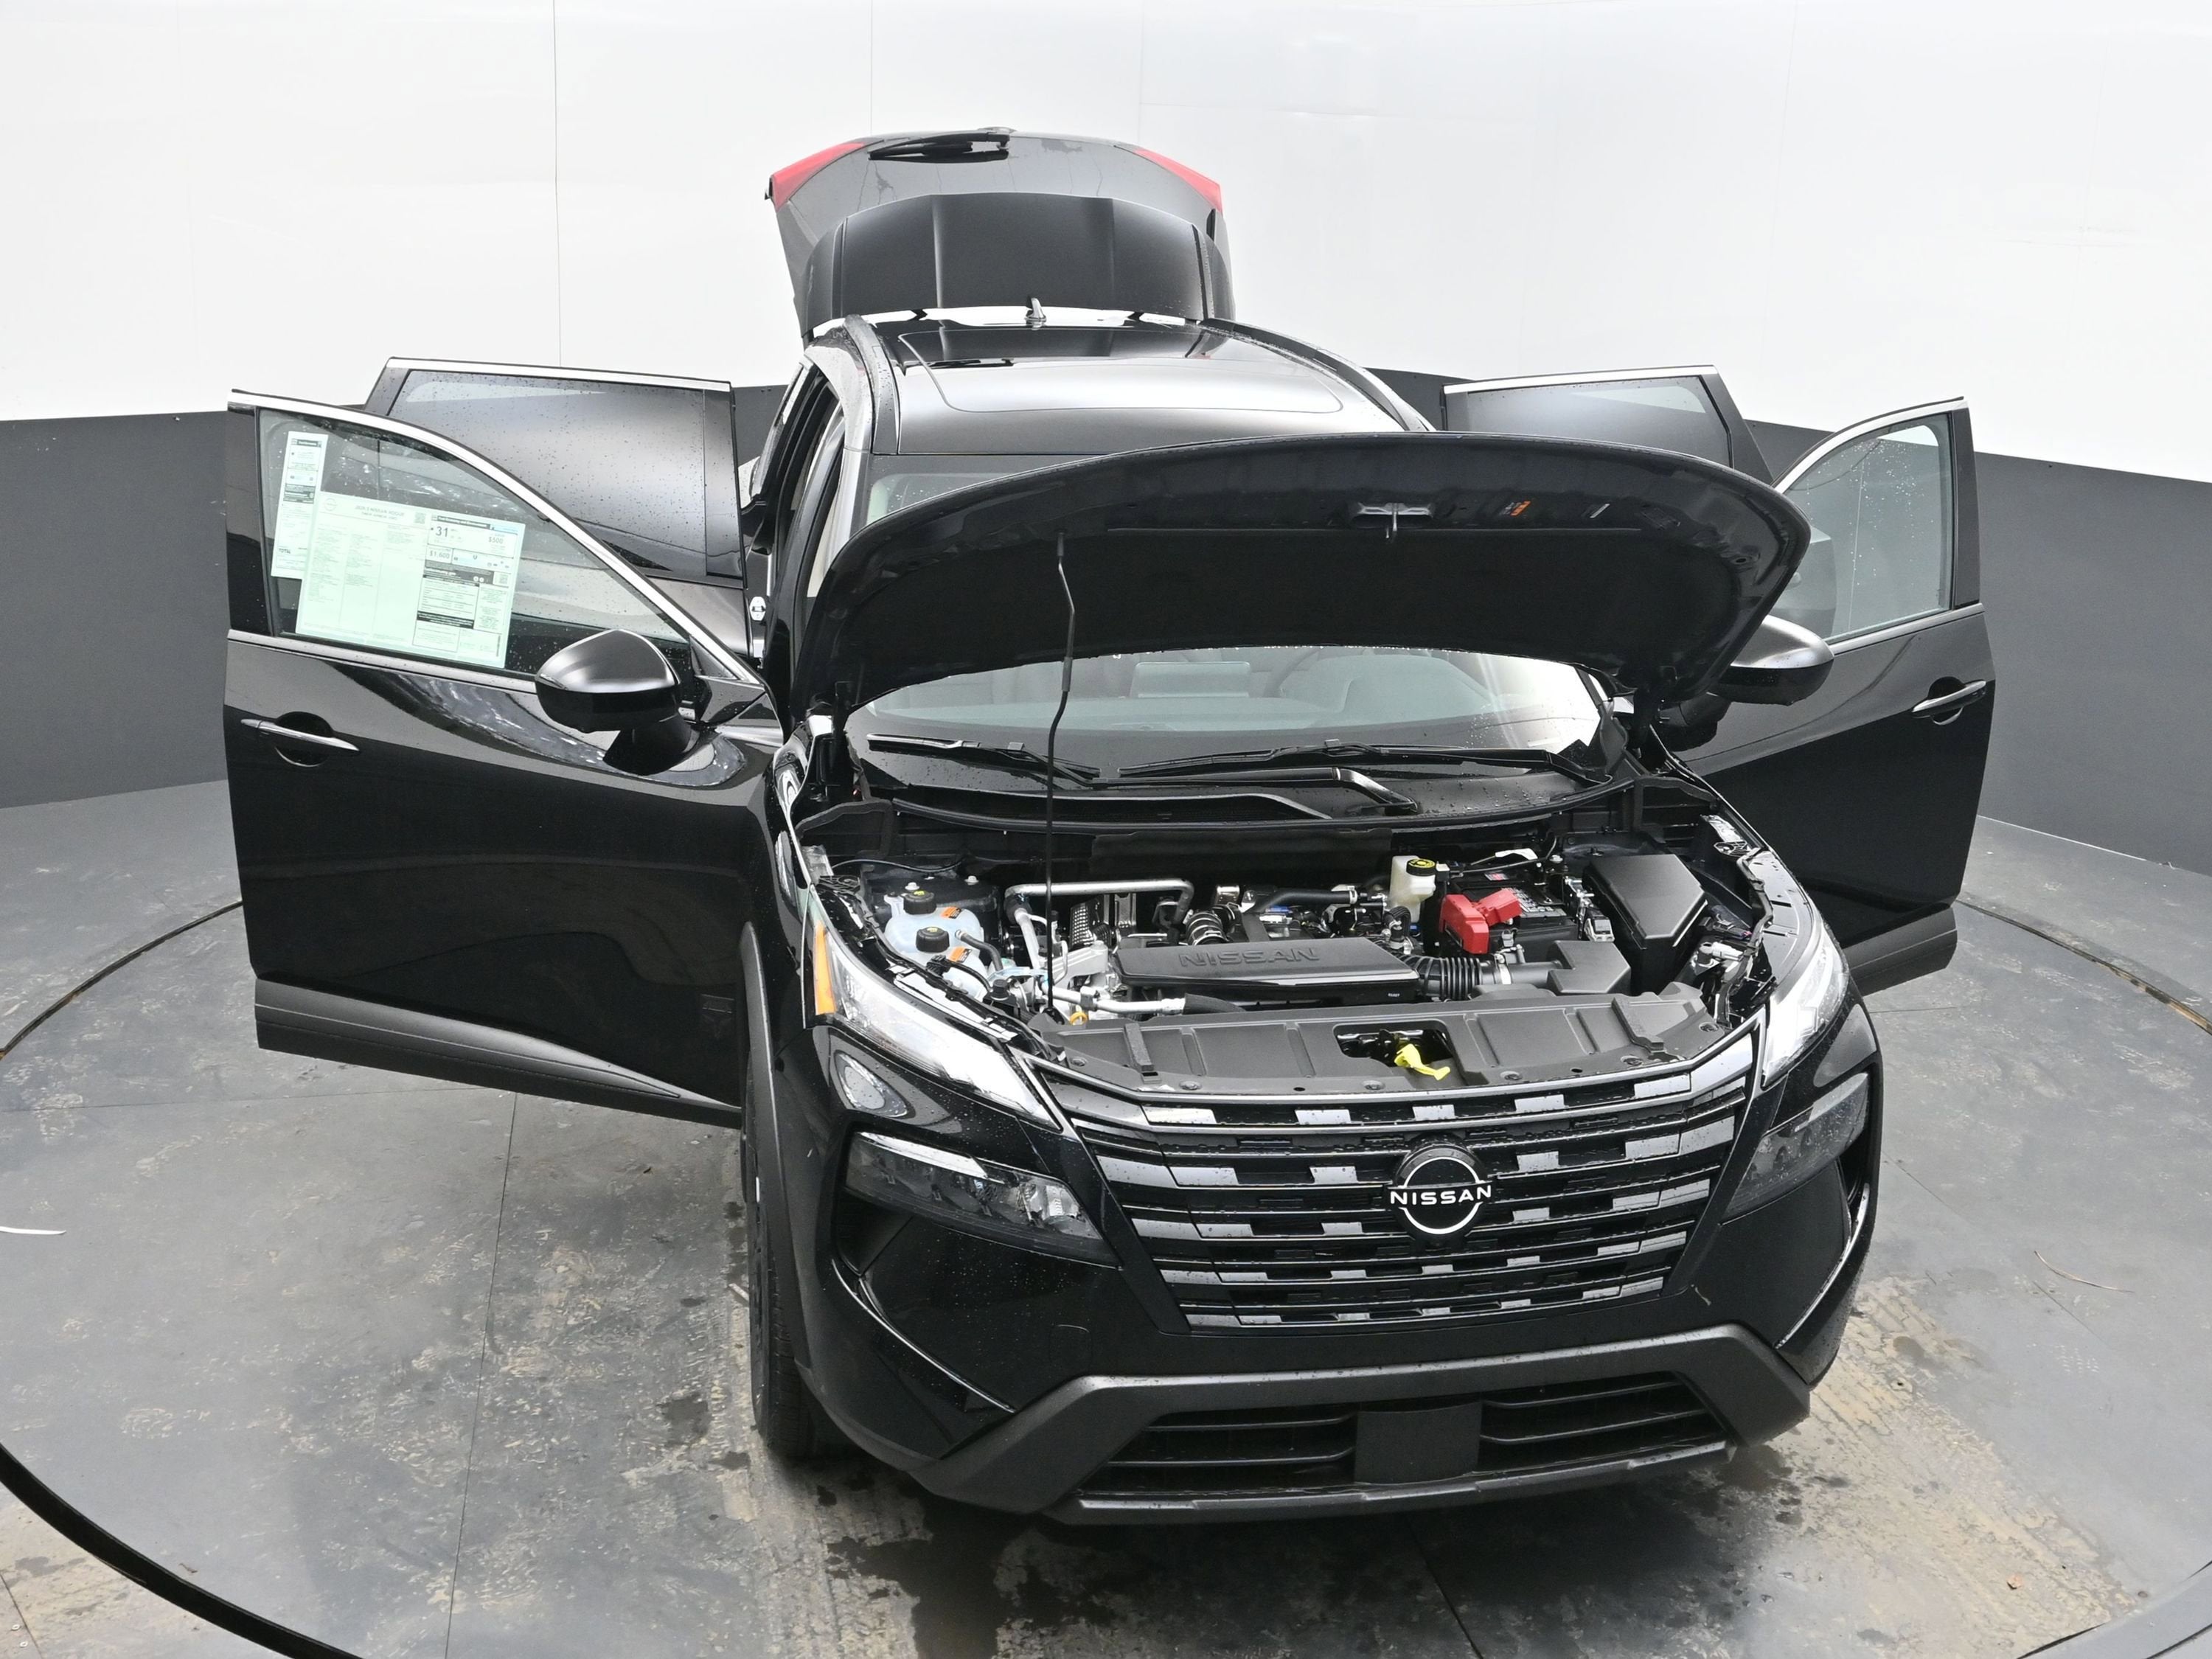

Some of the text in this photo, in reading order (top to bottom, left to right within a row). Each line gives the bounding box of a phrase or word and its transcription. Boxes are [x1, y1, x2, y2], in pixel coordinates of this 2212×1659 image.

[435, 526, 448, 538] 31
[1179, 947, 1320, 967] NISSAN
[1390, 1184, 1492, 1206] NISSAN
